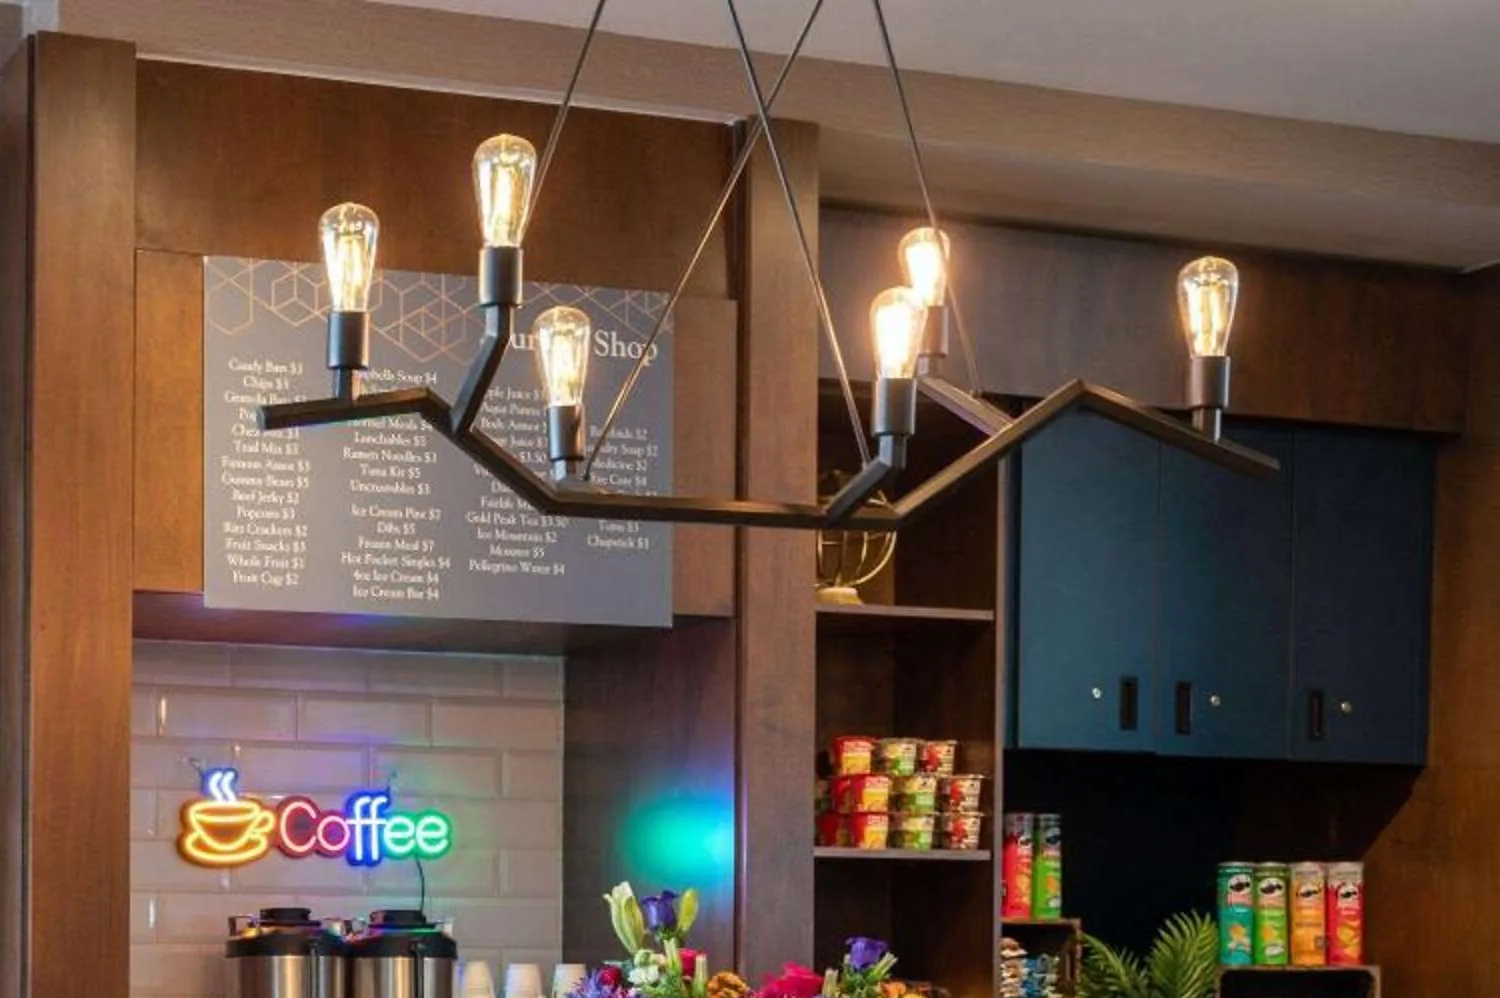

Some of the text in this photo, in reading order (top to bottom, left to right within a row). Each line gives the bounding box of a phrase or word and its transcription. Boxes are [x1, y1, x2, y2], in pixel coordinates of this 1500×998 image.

[594, 329, 658, 367] Shop
[244, 375, 273, 389] Chips
[262, 441, 283, 454] Mix
[619, 443, 646, 458] Soap
[221, 456, 263, 470] Famous
[343, 447, 380, 461] Ramen
[381, 450, 422, 464] Noodles
[359, 463, 387, 477] Tuna
[389, 465, 407, 477] Kit
[609, 473, 633, 486] Care
[233, 489, 256, 501] Beef
[258, 490, 285, 505] Jerky
[237, 506, 281, 521] Popcorn
[351, 504, 368, 516] Ice
[369, 505, 404, 518] Cream
[464, 511, 491, 525] Gold
[493, 512, 518, 526] Peak
[519, 513, 539, 527] Tea
[247, 523, 293, 536] Crackers
[477, 527, 493, 539] Ice
[494, 528, 544, 542] Mountain
[226, 538, 252, 551] Fruit
[254, 540, 291, 552] Snacks
[358, 536, 393, 549] Frozen
[394, 538, 420, 551] Meal
[587, 535, 636, 550] Chapstick
[227, 554, 261, 567] Whole
[263, 555, 290, 569] Fruit
[341, 552, 363, 564] Hot
[468, 559, 519, 575] Pellegrino
[520, 561, 552, 574] Water
[232, 570, 300, 587] Fruit Cup $2
[373, 569, 389, 581] Ice
[390, 570, 426, 582] Cream
[353, 584, 369, 597] Ice
[370, 585, 405, 599] Cream
[406, 586, 425, 600] Bar
[278, 796, 451, 861] Coffee
